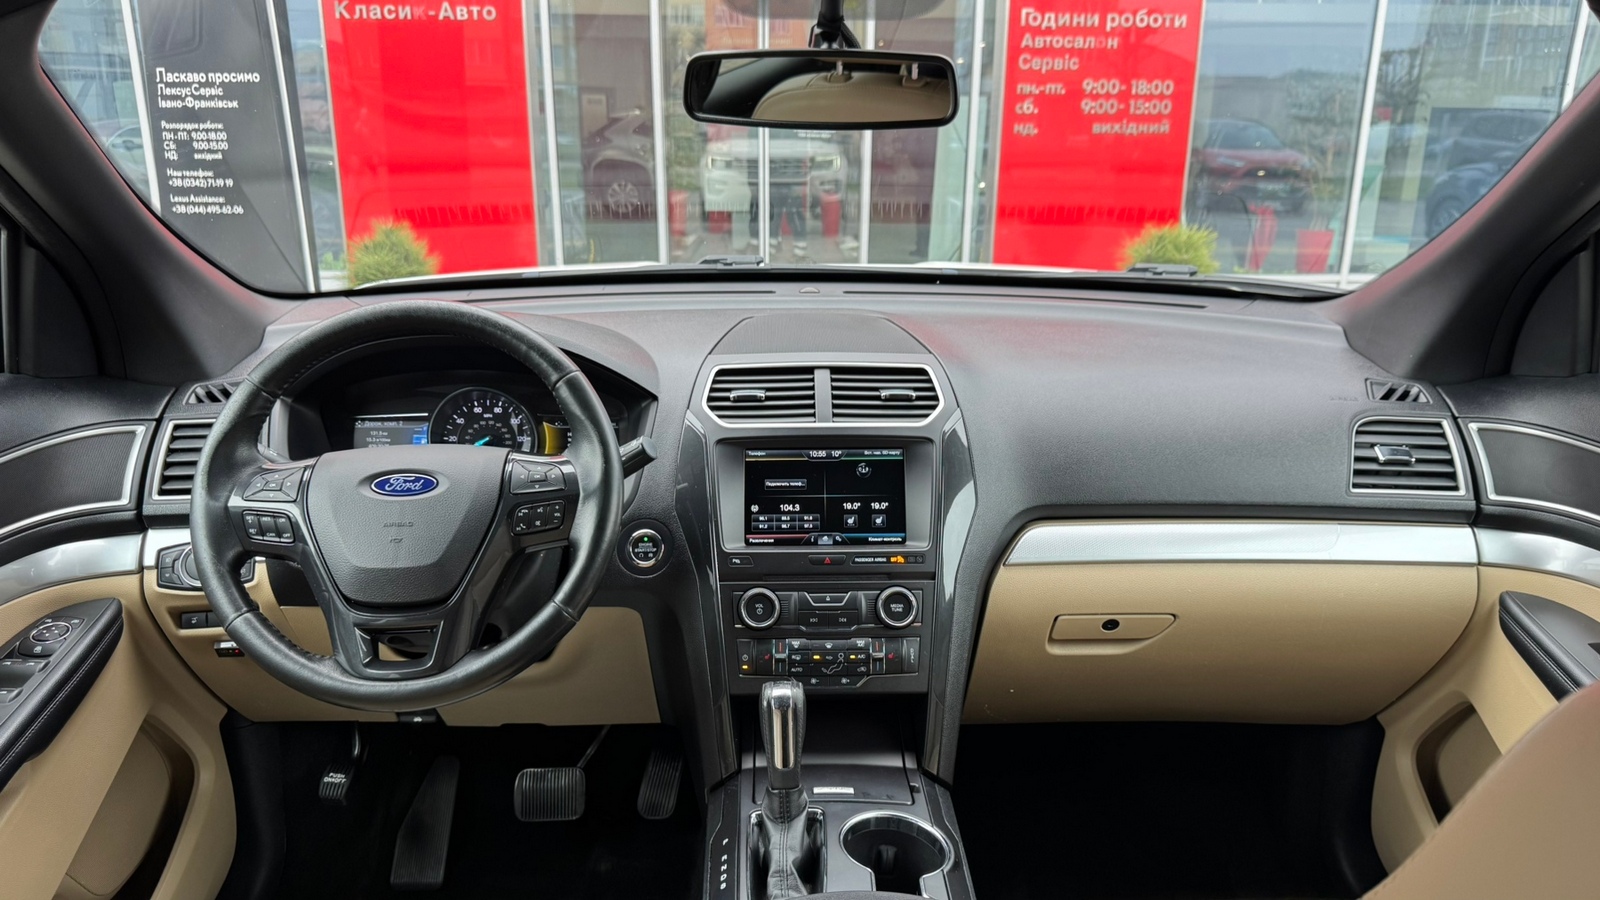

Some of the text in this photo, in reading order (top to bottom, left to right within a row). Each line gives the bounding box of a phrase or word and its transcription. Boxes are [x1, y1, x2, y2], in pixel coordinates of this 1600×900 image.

[335, 0, 497, 21] Класик-Авто
[1020, 8, 1188, 31] Години роботи
[1018, 53, 1080, 74] Сервіс
[156, 67, 260, 85] Ласкаво просимо
[158, 96, 239, 110] Івано-Франківськ
[1015, 98, 1038, 115] сб.
[1013, 119, 1170, 136] нд. вихідний
[385, 476, 425, 491] Ford
[779, 504, 800, 512] 104.3
[720, 873, 727, 882] D
